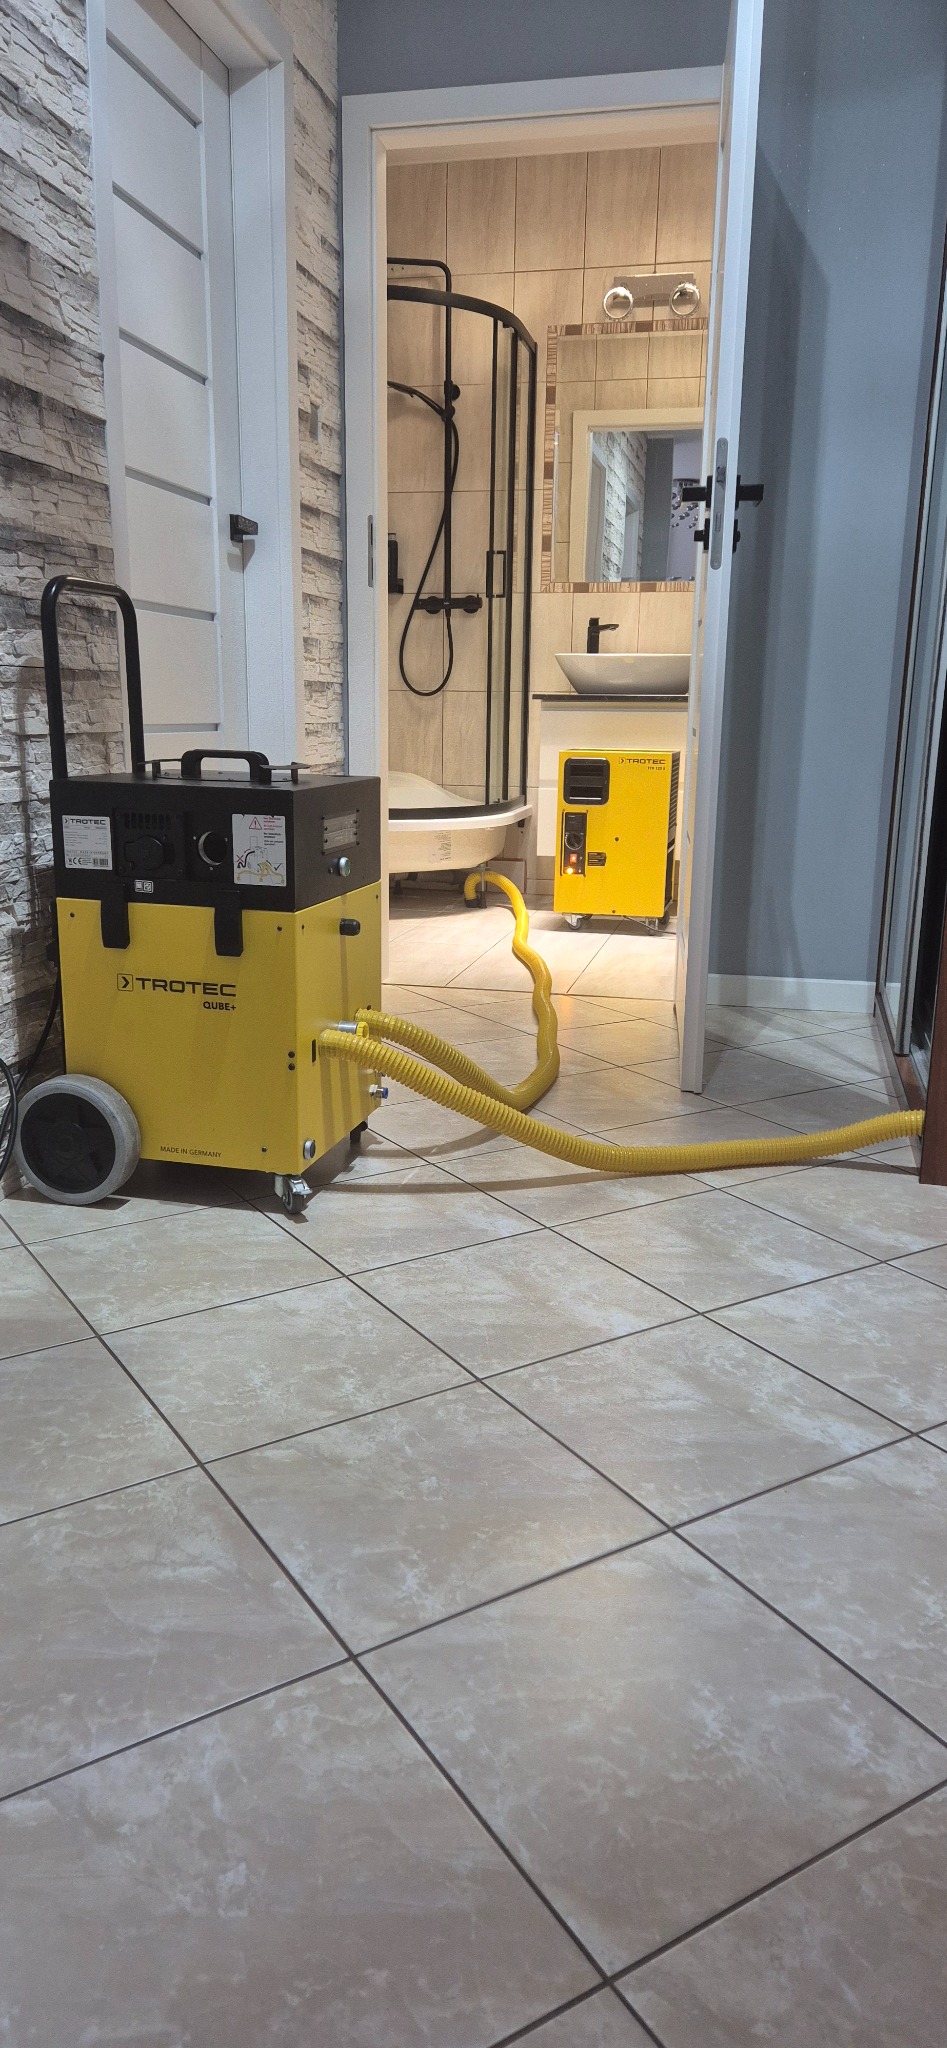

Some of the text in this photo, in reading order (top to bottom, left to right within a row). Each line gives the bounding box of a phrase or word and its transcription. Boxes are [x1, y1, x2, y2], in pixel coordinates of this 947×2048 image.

[135, 977, 236, 997] TROTEC
[203, 1001, 236, 1011] QUBE+
[160, 1146, 179, 1154] MADE
[189, 1149, 222, 1158] GERMANY
